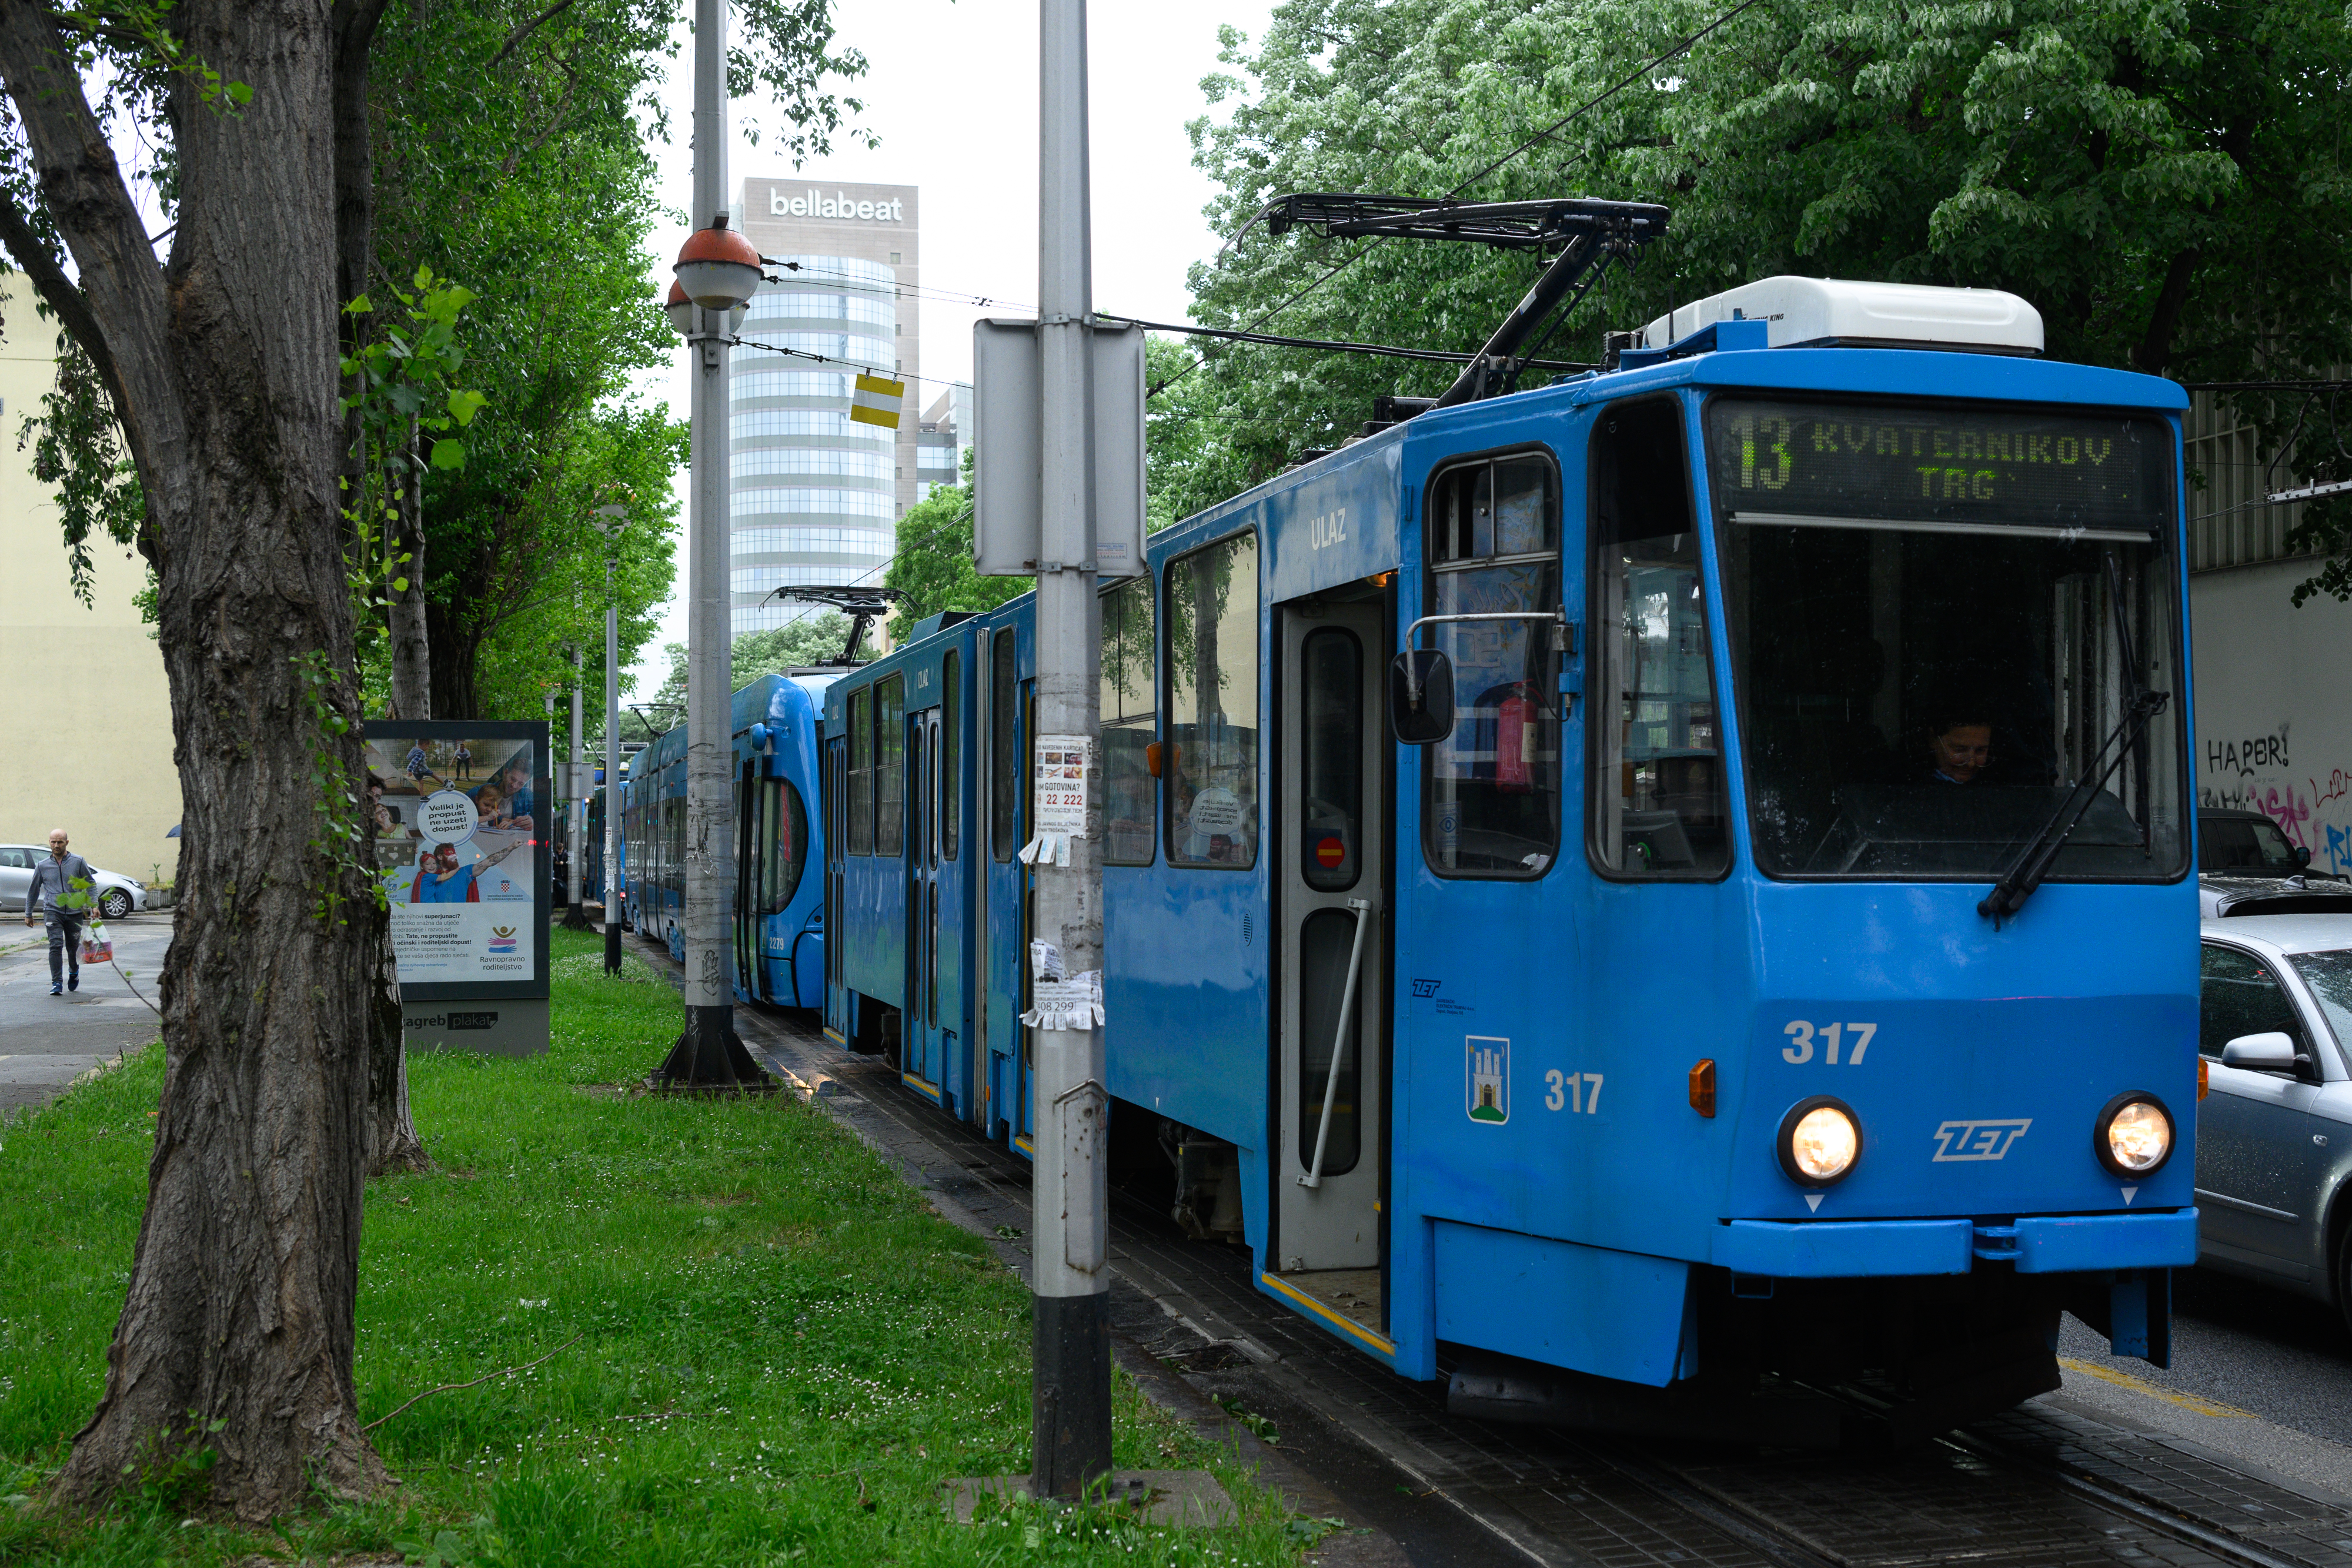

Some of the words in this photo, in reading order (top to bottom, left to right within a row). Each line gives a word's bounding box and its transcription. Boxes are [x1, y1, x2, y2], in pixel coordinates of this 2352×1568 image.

[770, 187, 903, 221] bellabeat
[1769, 313, 1784, 322] KING
[1730, 414, 1791, 490] 13
[1812, 423, 2110, 466] KVATERNIKOV
[1916, 467, 1996, 500] TRG
[1311, 507, 1347, 550] ULAZ
[918, 668, 929, 689] IZLAZ
[1045, 783, 1081, 791] GOTOVINA?
[429, 803, 454, 811] Veliki
[1047, 794, 1057, 804] 22
[1064, 794, 1083, 805] 222
[428, 810, 467, 820] propust
[432, 823, 468, 833] dopust!
[769, 937, 784, 951] 2279
[1412, 979, 1441, 998] ZET
[1055, 1002, 1074, 1011] 299
[403, 1015, 446, 1029] zagreb
[453, 1014, 492, 1029] plakat
[1782, 1020, 1877, 1065] 317
[1544, 1069, 1604, 1114] 317
[1932, 1118, 2033, 1162] ZET
